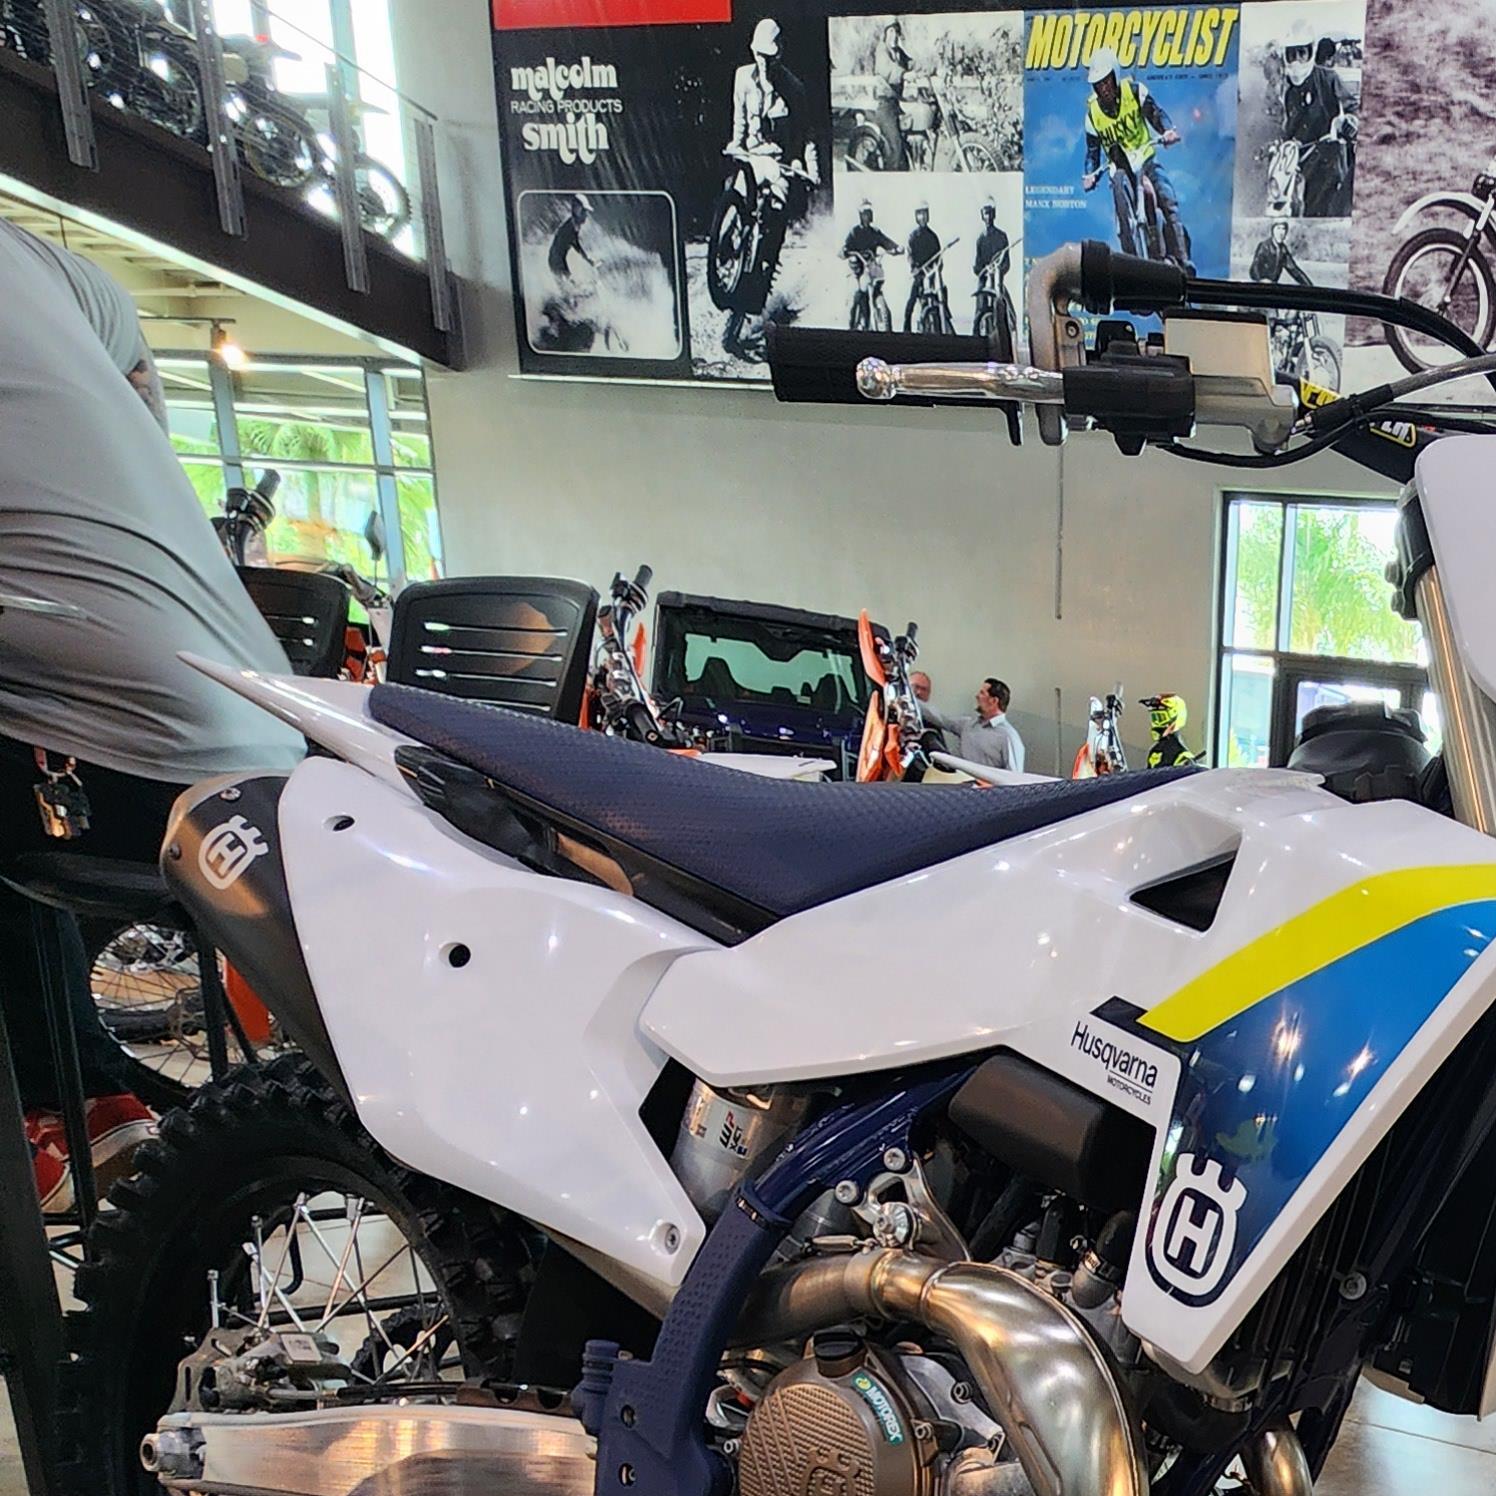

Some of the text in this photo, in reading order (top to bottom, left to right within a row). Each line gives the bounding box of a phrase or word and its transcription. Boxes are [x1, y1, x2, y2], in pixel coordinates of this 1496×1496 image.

[1025, 8, 1239, 70] MOTORCYCLIST
[510, 55, 619, 101] malcolm
[510, 98, 624, 114] RACING PRODUCTS
[522, 112, 610, 165] smith
[1070, 1020, 1159, 1089] Husqvarna
[1106, 1074, 1152, 1106] MOTORCYCLES
[866, 1386, 903, 1443] MOTOREX
